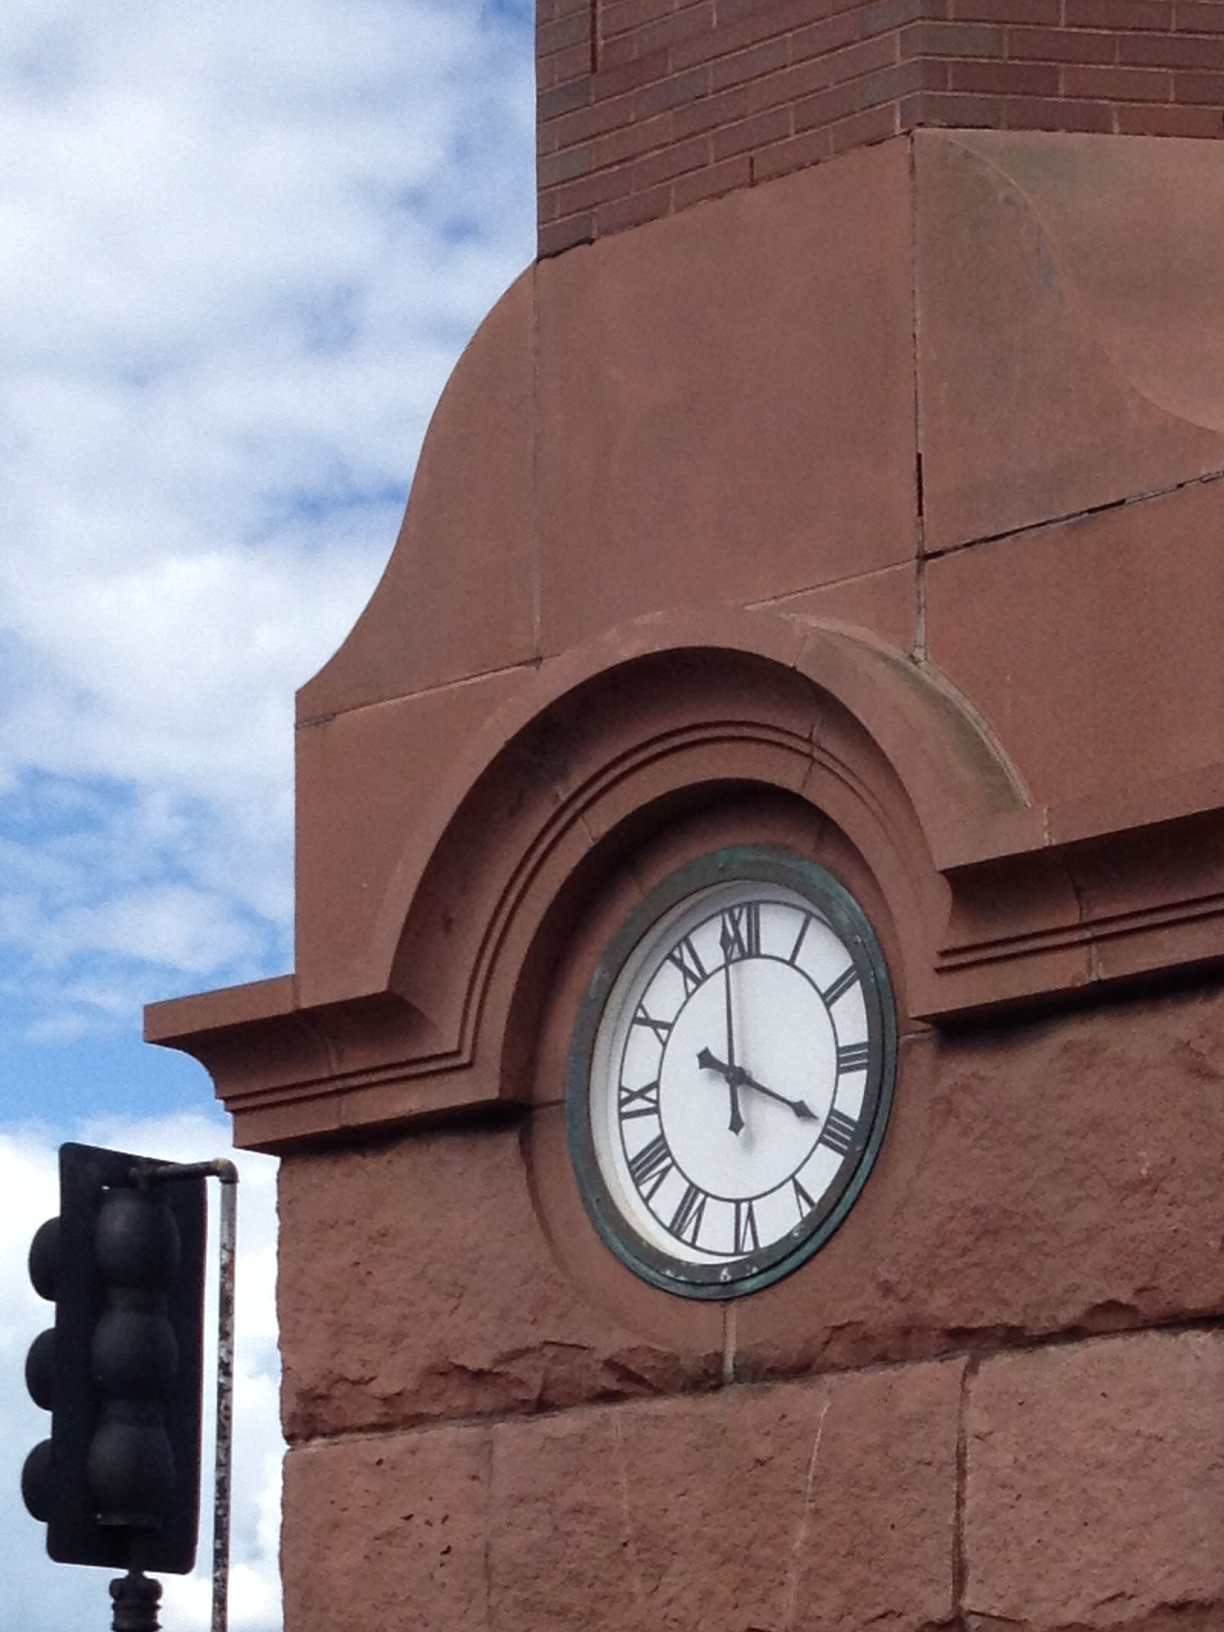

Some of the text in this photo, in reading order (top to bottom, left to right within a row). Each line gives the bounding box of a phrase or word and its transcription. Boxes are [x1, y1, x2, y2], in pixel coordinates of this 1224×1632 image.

[789, 915, 812, 964] I
[667, 937, 708, 998] XI
[821, 963, 860, 1007] II
[632, 1001, 673, 1047] X
[837, 1042, 869, 1074] III
[619, 1080, 660, 1120] IX
[818, 1109, 856, 1156] IIII
[629, 1135, 674, 1204] VIII
[668, 1184, 706, 1247] VII
[792, 1173, 816, 1219] V
[734, 1200, 760, 1253] VI
